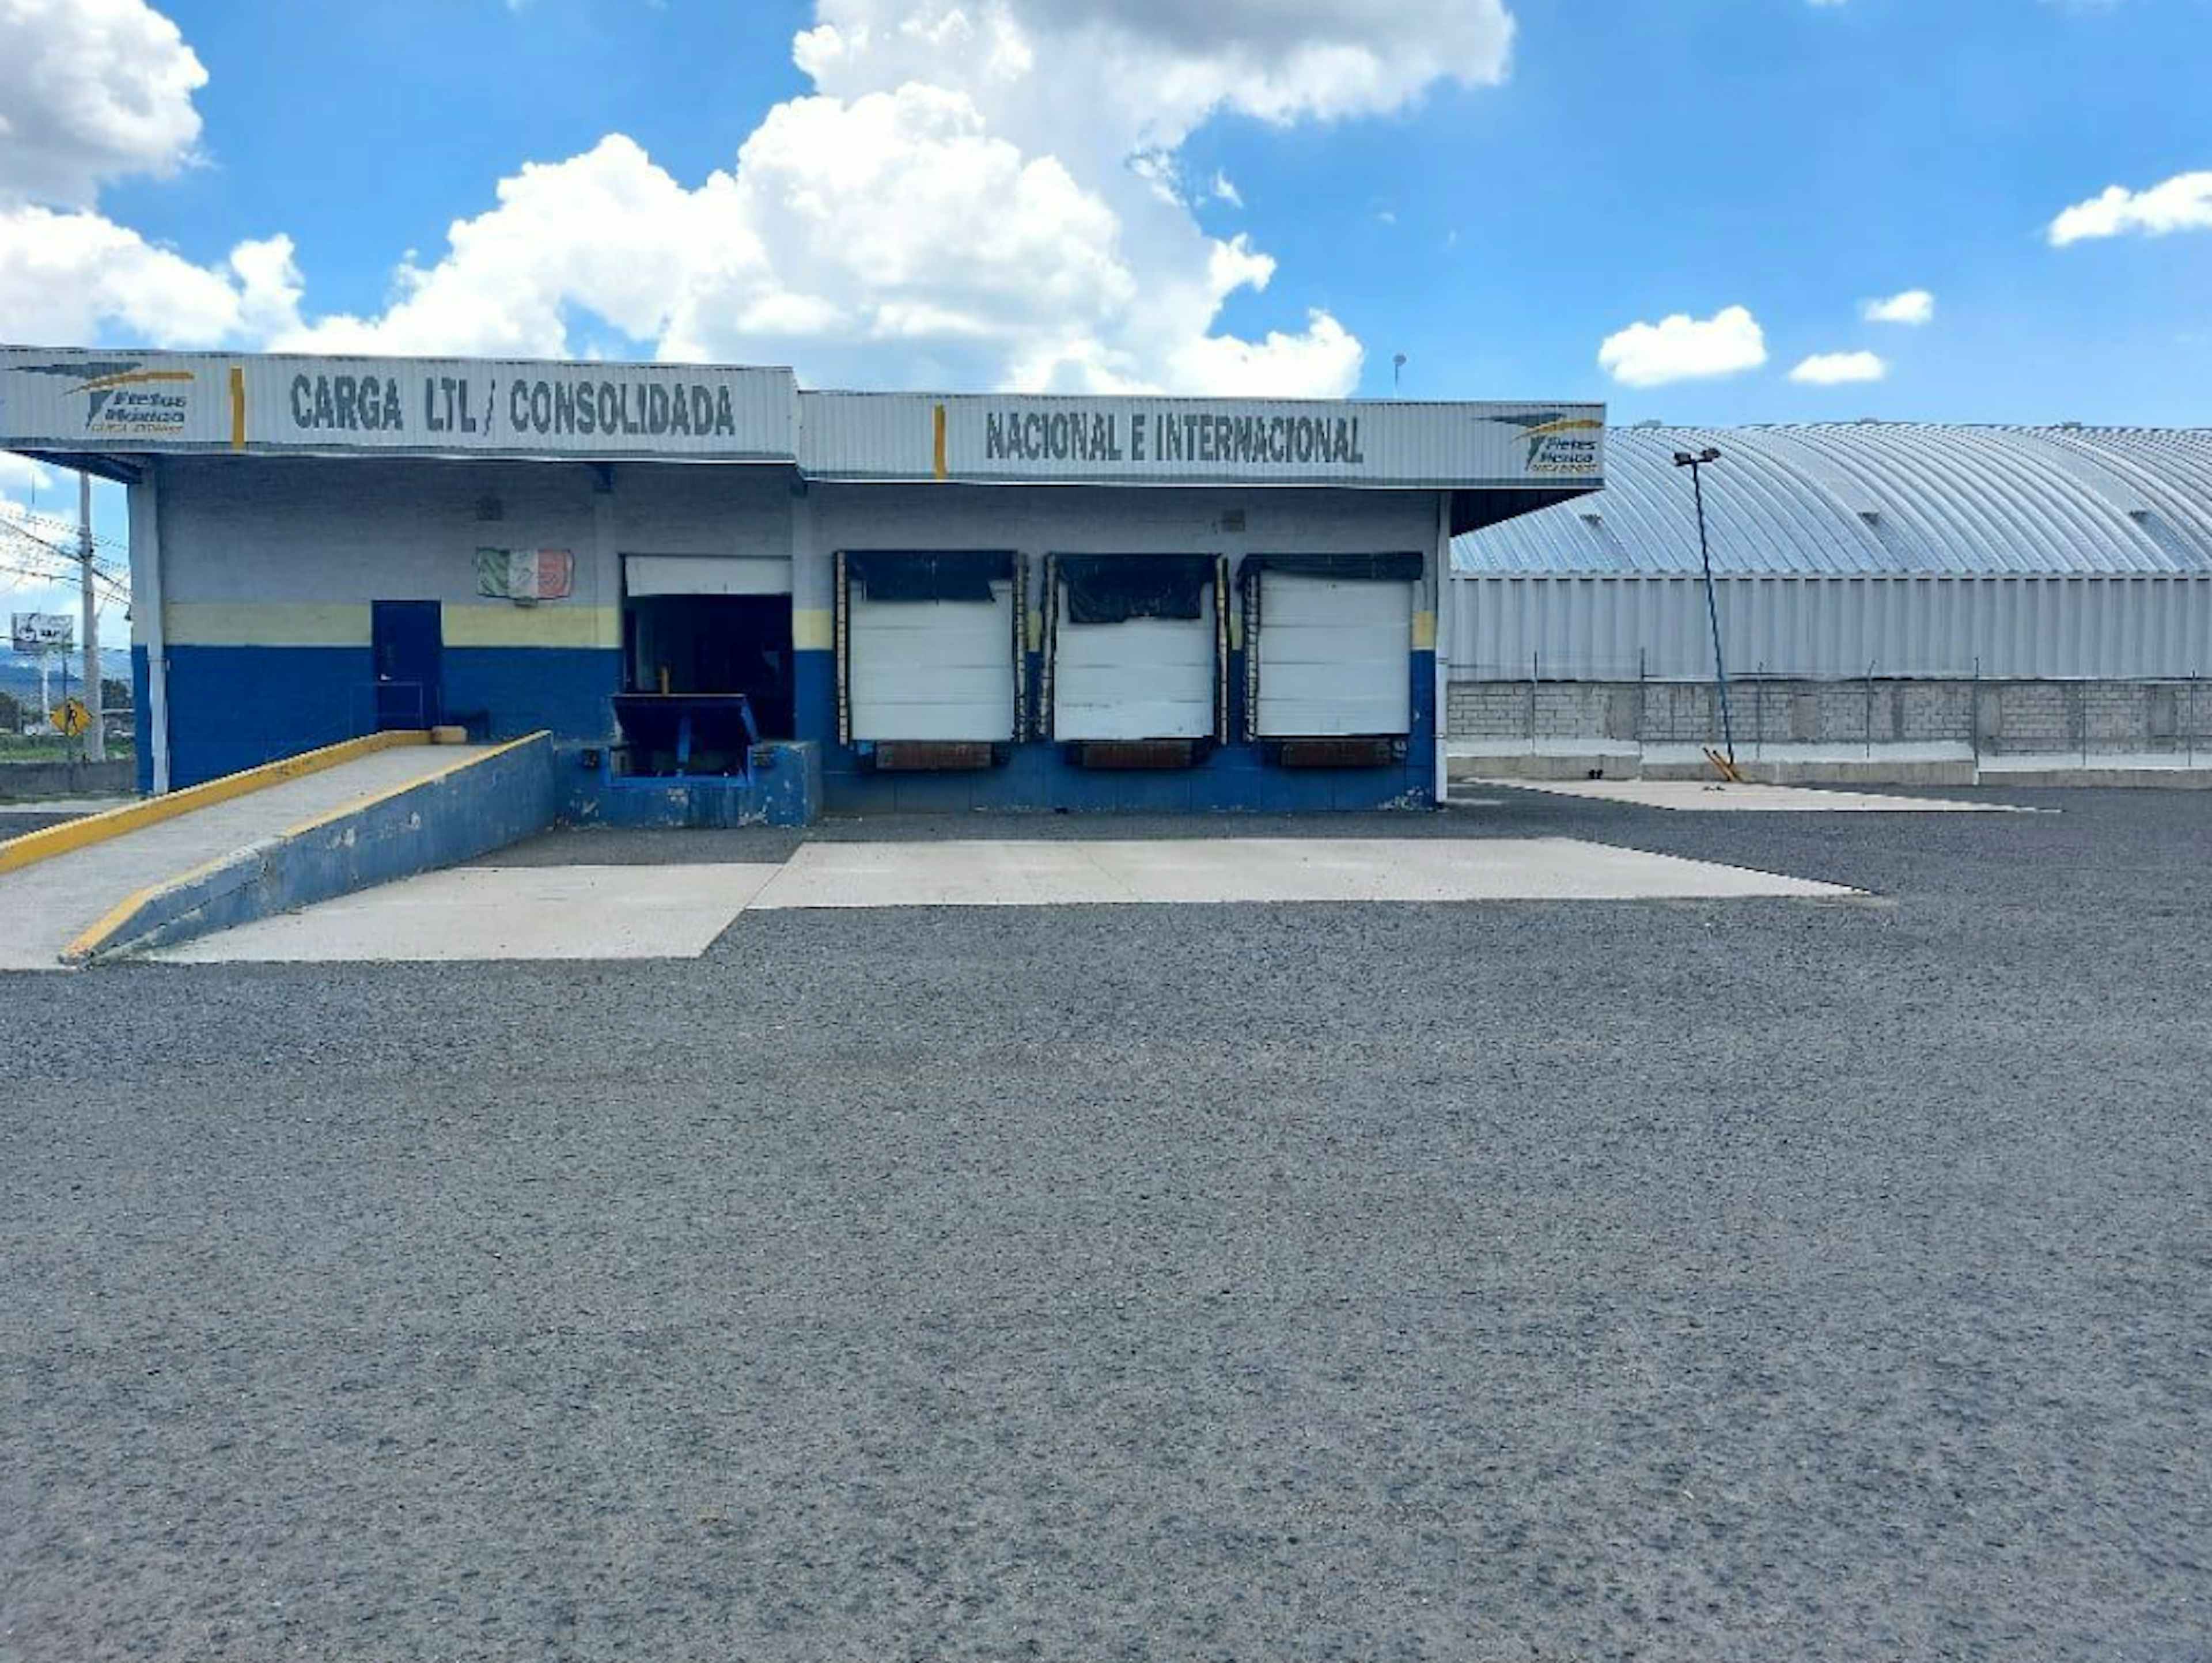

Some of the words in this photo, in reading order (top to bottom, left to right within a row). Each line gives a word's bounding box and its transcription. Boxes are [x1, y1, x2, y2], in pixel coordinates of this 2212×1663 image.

[291, 374, 403, 431] CARGA
[510, 379, 736, 436] CONSOLIDADA
[986, 412, 1122, 461] NACIONAL
[1131, 413, 1145, 461] E
[1157, 412, 1363, 463] INTERNACIONAL
